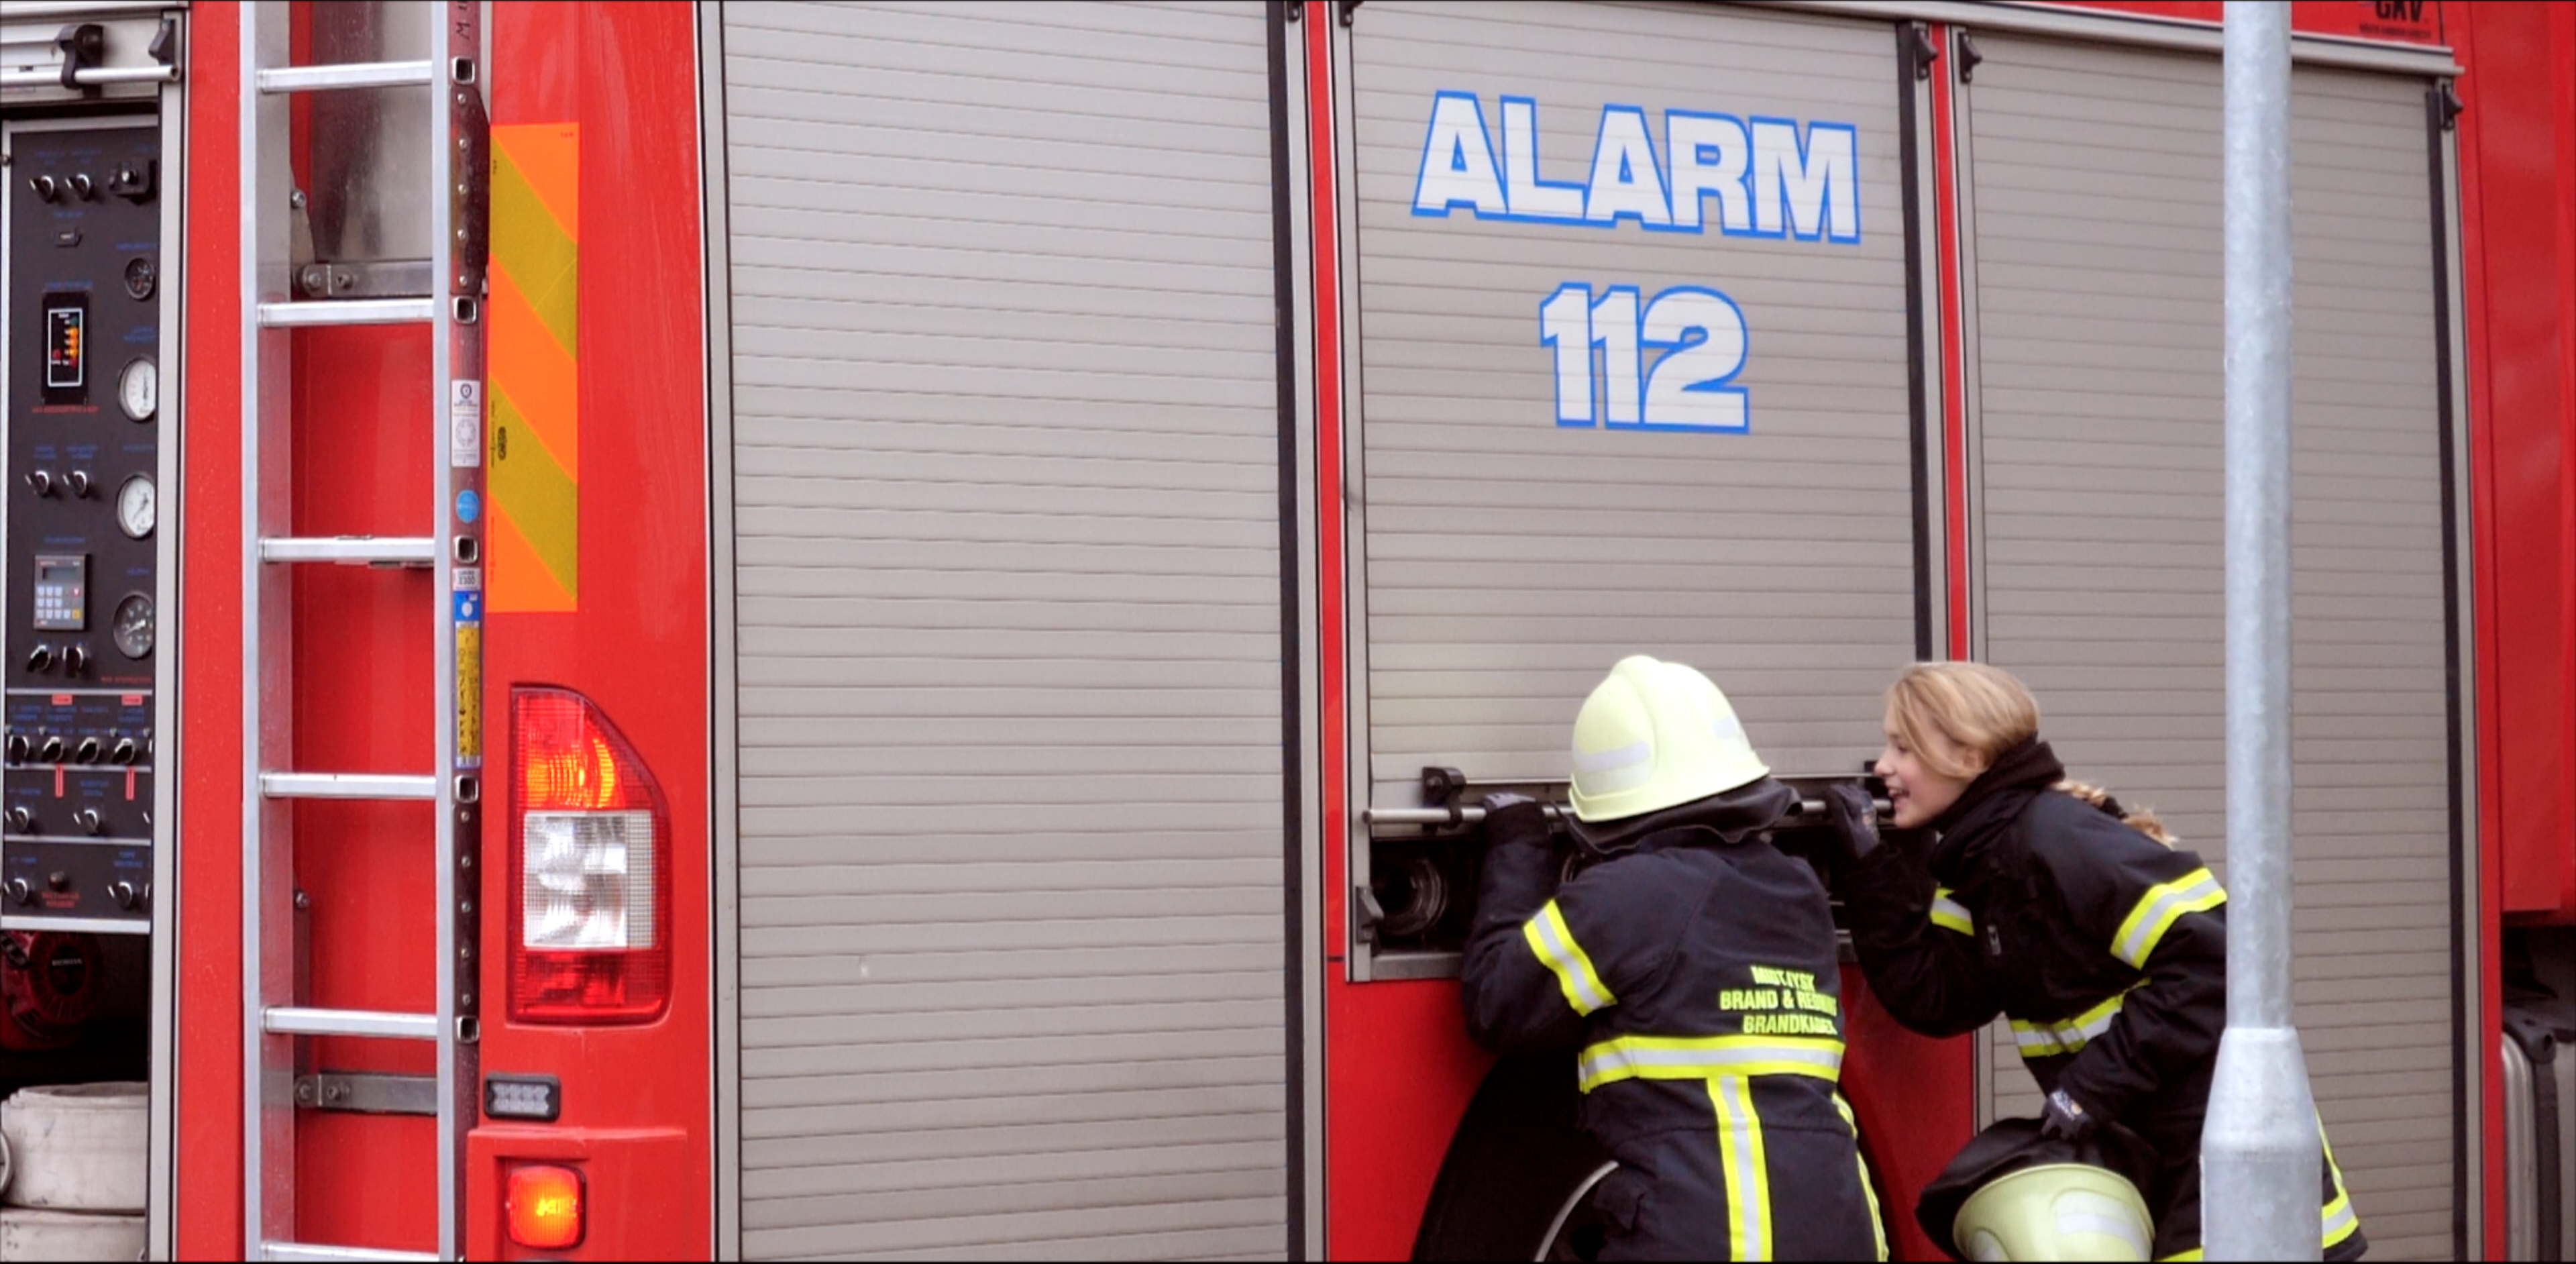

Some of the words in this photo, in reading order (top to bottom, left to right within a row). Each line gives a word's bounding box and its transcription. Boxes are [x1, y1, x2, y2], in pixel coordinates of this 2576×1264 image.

[1411, 90, 1860, 244] ALARM
[1539, 282, 1750, 434] 112
[1719, 990, 1778, 1010] BRAND
[1782, 989, 1794, 1009] &
